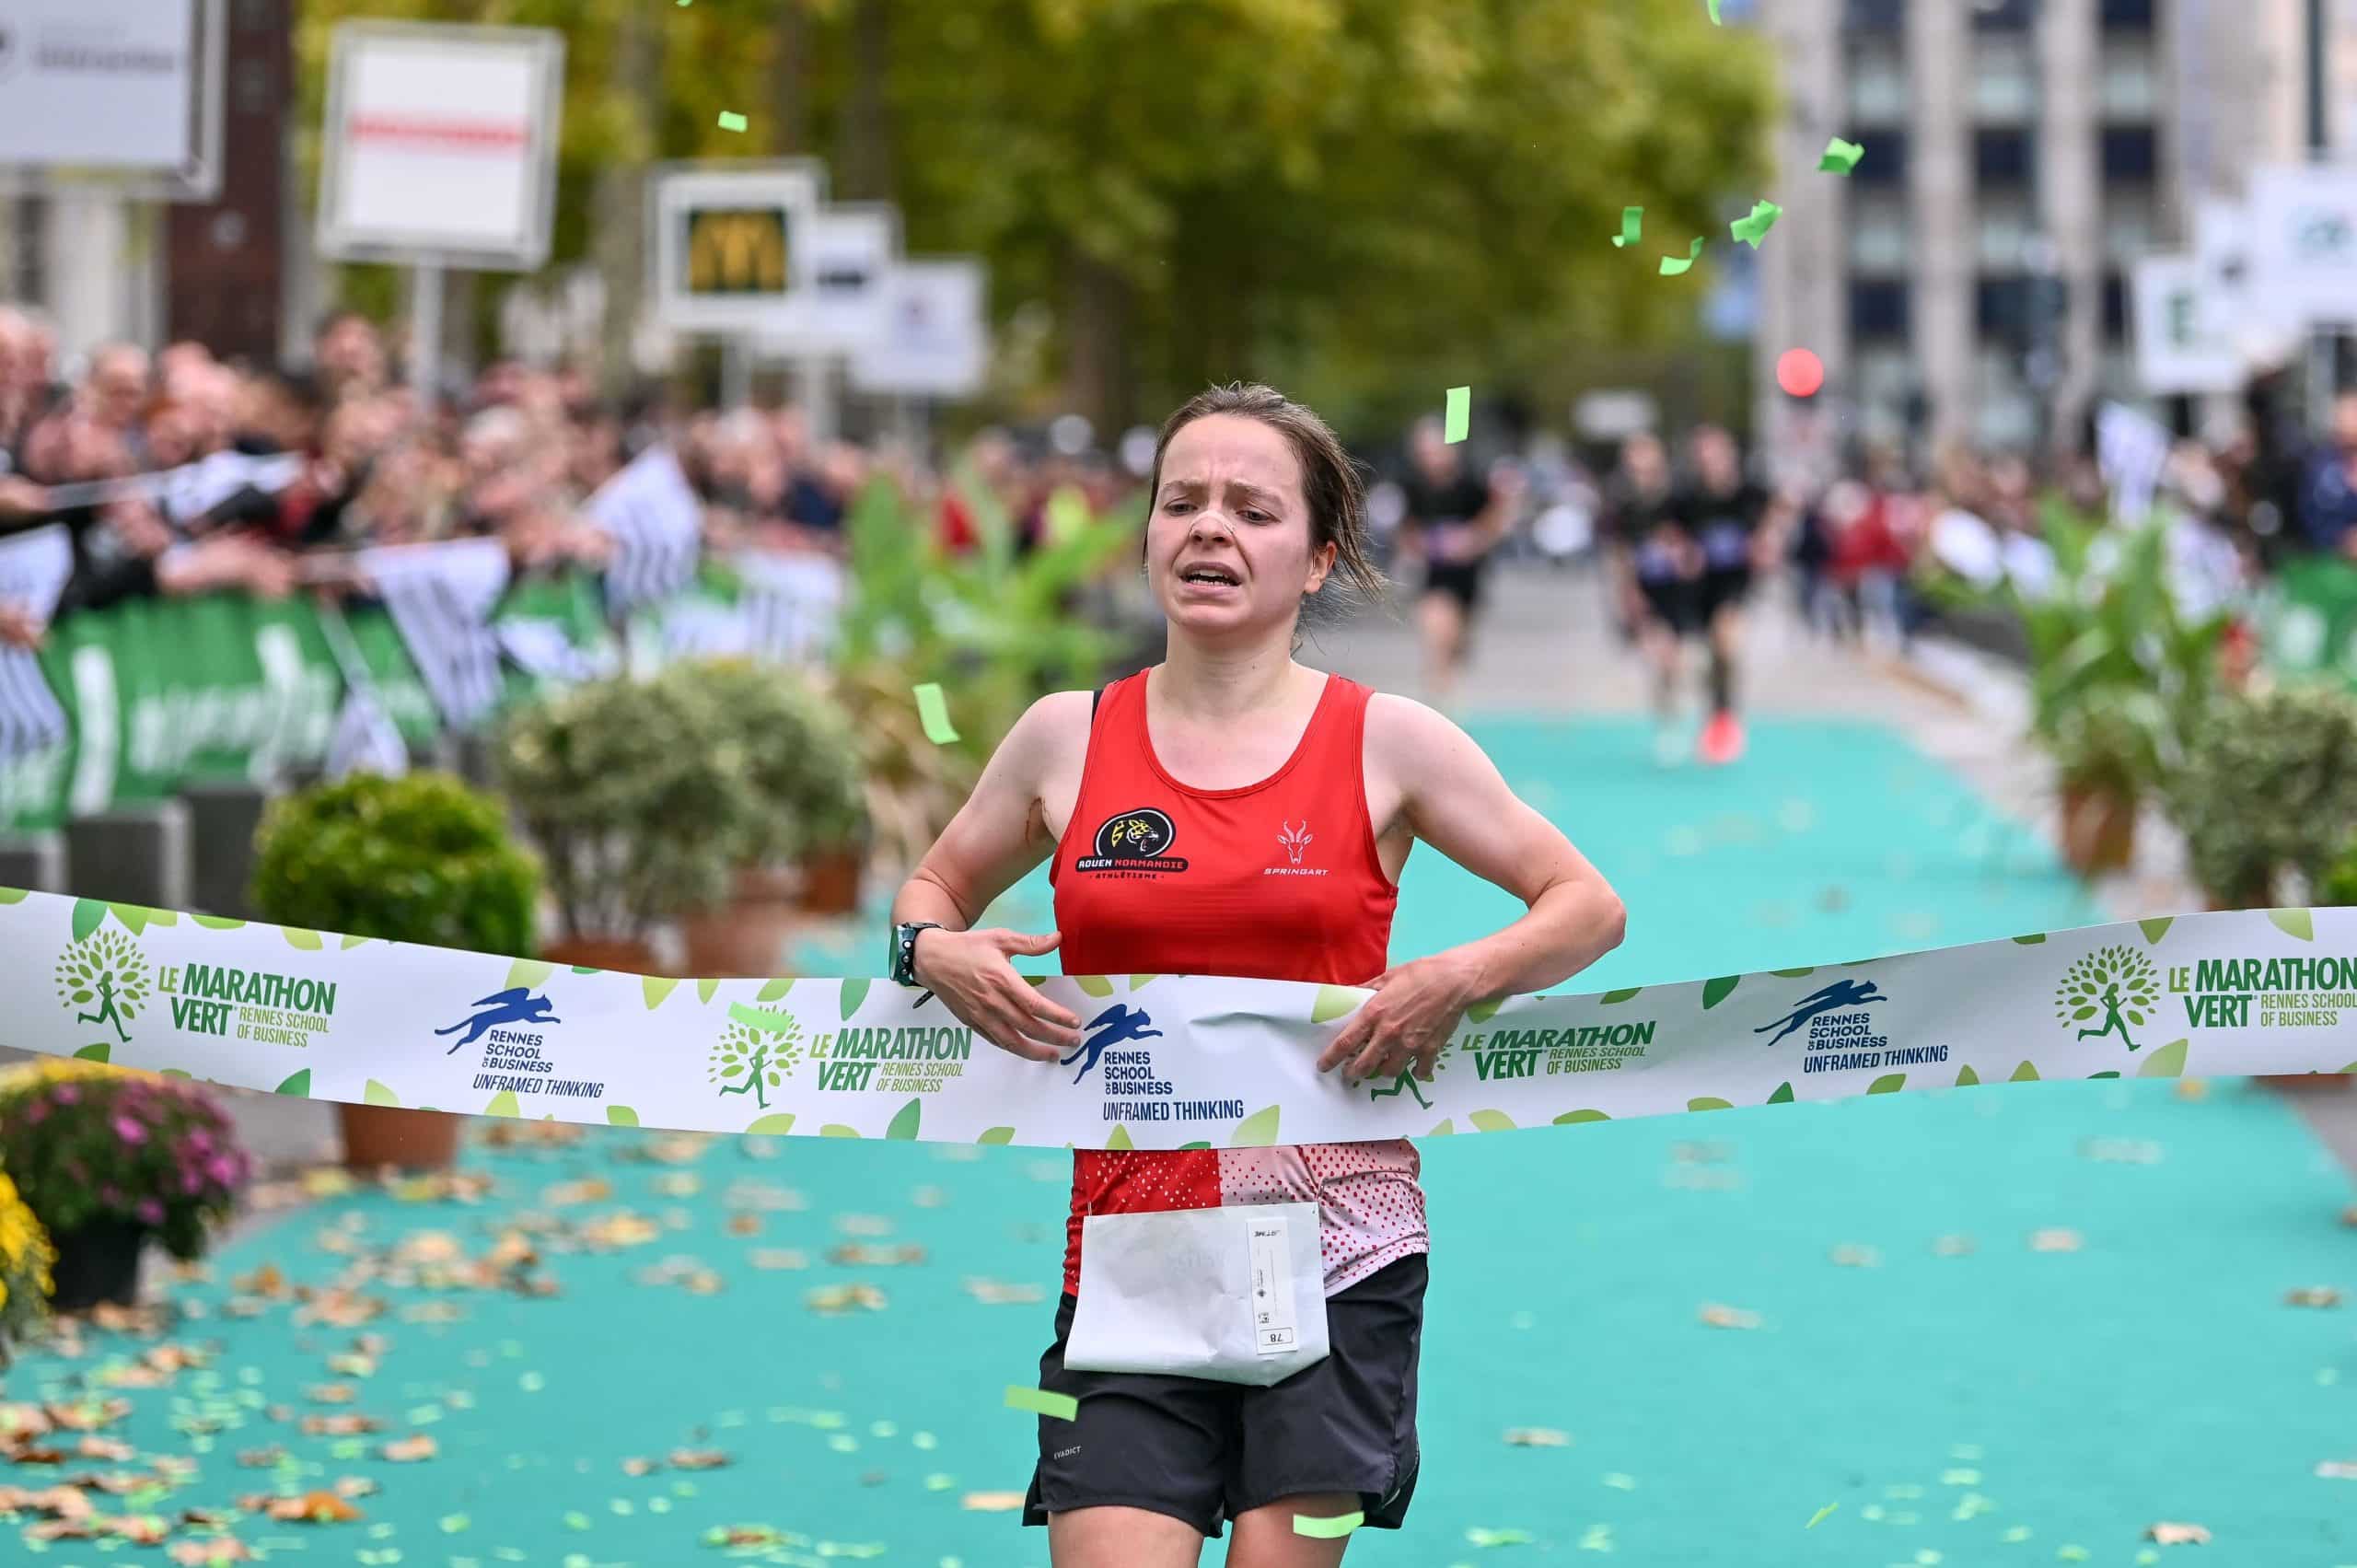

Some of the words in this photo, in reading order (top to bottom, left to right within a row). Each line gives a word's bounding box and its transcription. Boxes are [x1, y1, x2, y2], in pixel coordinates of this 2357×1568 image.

[1078, 859, 1112, 868] ROUEN
[1114, 859, 1183, 869] NORMANDIE
[2169, 967, 2189, 993] LE
[2195, 958, 2357, 992] MARATHON
[158, 966, 179, 993] LE
[182, 963, 337, 1015] MARATHON
[2261, 994, 2308, 1009] RENNES
[171, 996, 232, 1036] VERT
[238, 1006, 284, 1027] RENNES
[285, 1012, 329, 1032] SCHOOL
[2184, 994, 2253, 1028] VERT
[2260, 1013, 2275, 1028] OF
[2279, 1011, 2338, 1027] BUSINESS
[1812, 1013, 1870, 1028] RENNES
[237, 1023, 250, 1040] OF
[253, 1027, 308, 1048] BUSINESS
[489, 1029, 543, 1047] RENNES
[1460, 1034, 1486, 1051] LE
[1487, 1020, 1656, 1050] MARATHON
[1809, 1025, 1872, 1040] SCHOOL
[485, 1043, 541, 1060] SCHOOL
[809, 1034, 832, 1058] LE
[831, 1027, 972, 1060] MARATHON
[1816, 1036, 1887, 1051] BUSINESS
[1104, 1051, 1151, 1064] RENNES
[1550, 1047, 1599, 1060] RENNES
[1601, 1046, 1645, 1058] SCHOOL
[1804, 1052, 1881, 1074] UNFRAMED
[1884, 1045, 1949, 1066] THINKING
[489, 1059, 553, 1073] BUSINESS
[881, 1063, 922, 1076] RENNES
[923, 1063, 963, 1076] SCHOOL
[1104, 1066, 1155, 1080] SCHOOL
[1474, 1050, 1543, 1081] VERT
[1546, 1061, 1562, 1075] OF
[1564, 1058, 1621, 1073] BUSINESS
[819, 1061, 877, 1091] VERT
[876, 1077, 889, 1092] OF
[891, 1078, 942, 1092] BUSINESS
[472, 1074, 543, 1094] UNFRAMED
[545, 1079, 604, 1098] THINKING
[1111, 1081, 1173, 1095] BUSINESS
[1103, 1101, 1170, 1121] UNFRAMED
[1173, 1099, 1244, 1121] THINKING
[1270, 1333, 1283, 1342] 78
